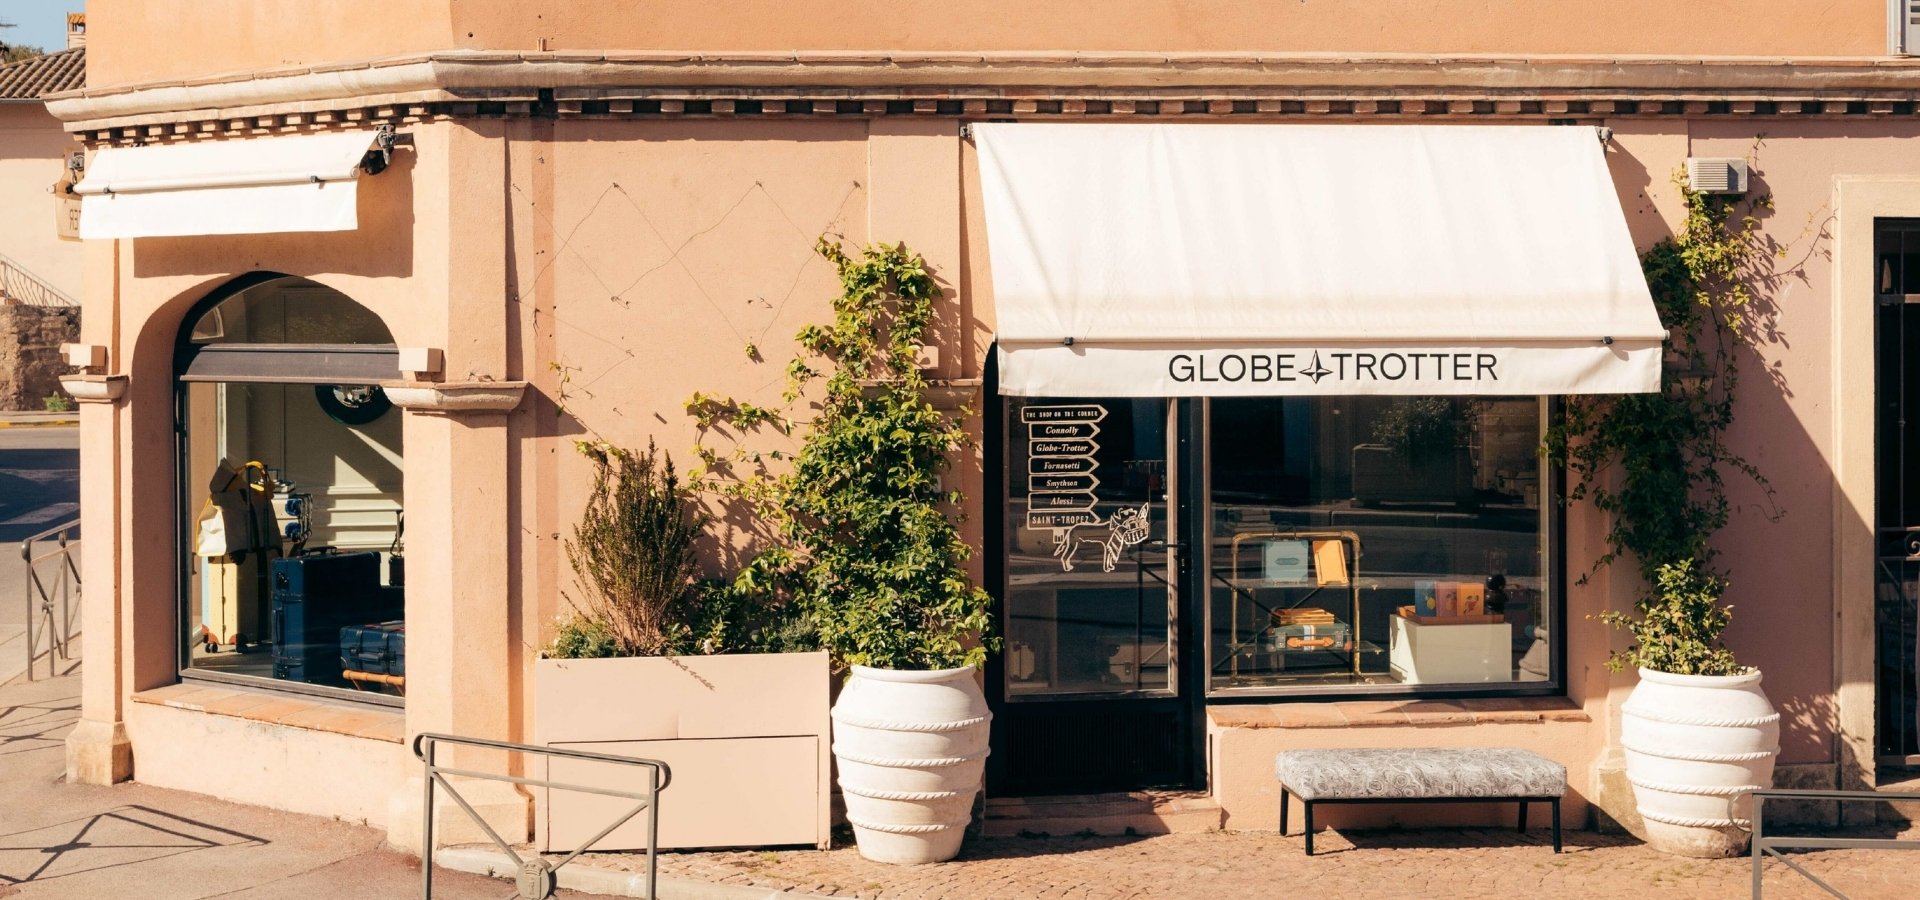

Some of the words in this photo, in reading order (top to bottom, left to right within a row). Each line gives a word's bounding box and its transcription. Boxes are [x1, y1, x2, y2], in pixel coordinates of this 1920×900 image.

[1168, 354, 1296, 382] GLOBE
[1331, 353, 1498, 381] TROTTER
[1064, 410, 1074, 418] THE
[1045, 426, 1079, 436] Connolly
[1036, 443, 1088, 452] Globe-Trotter
[1043, 461, 1080, 470] Fornasetti
[1046, 479, 1078, 488] Smythson
[1050, 496, 1073, 505] Alessi
[1032, 516, 1089, 525] SAINT-TROPEZ
